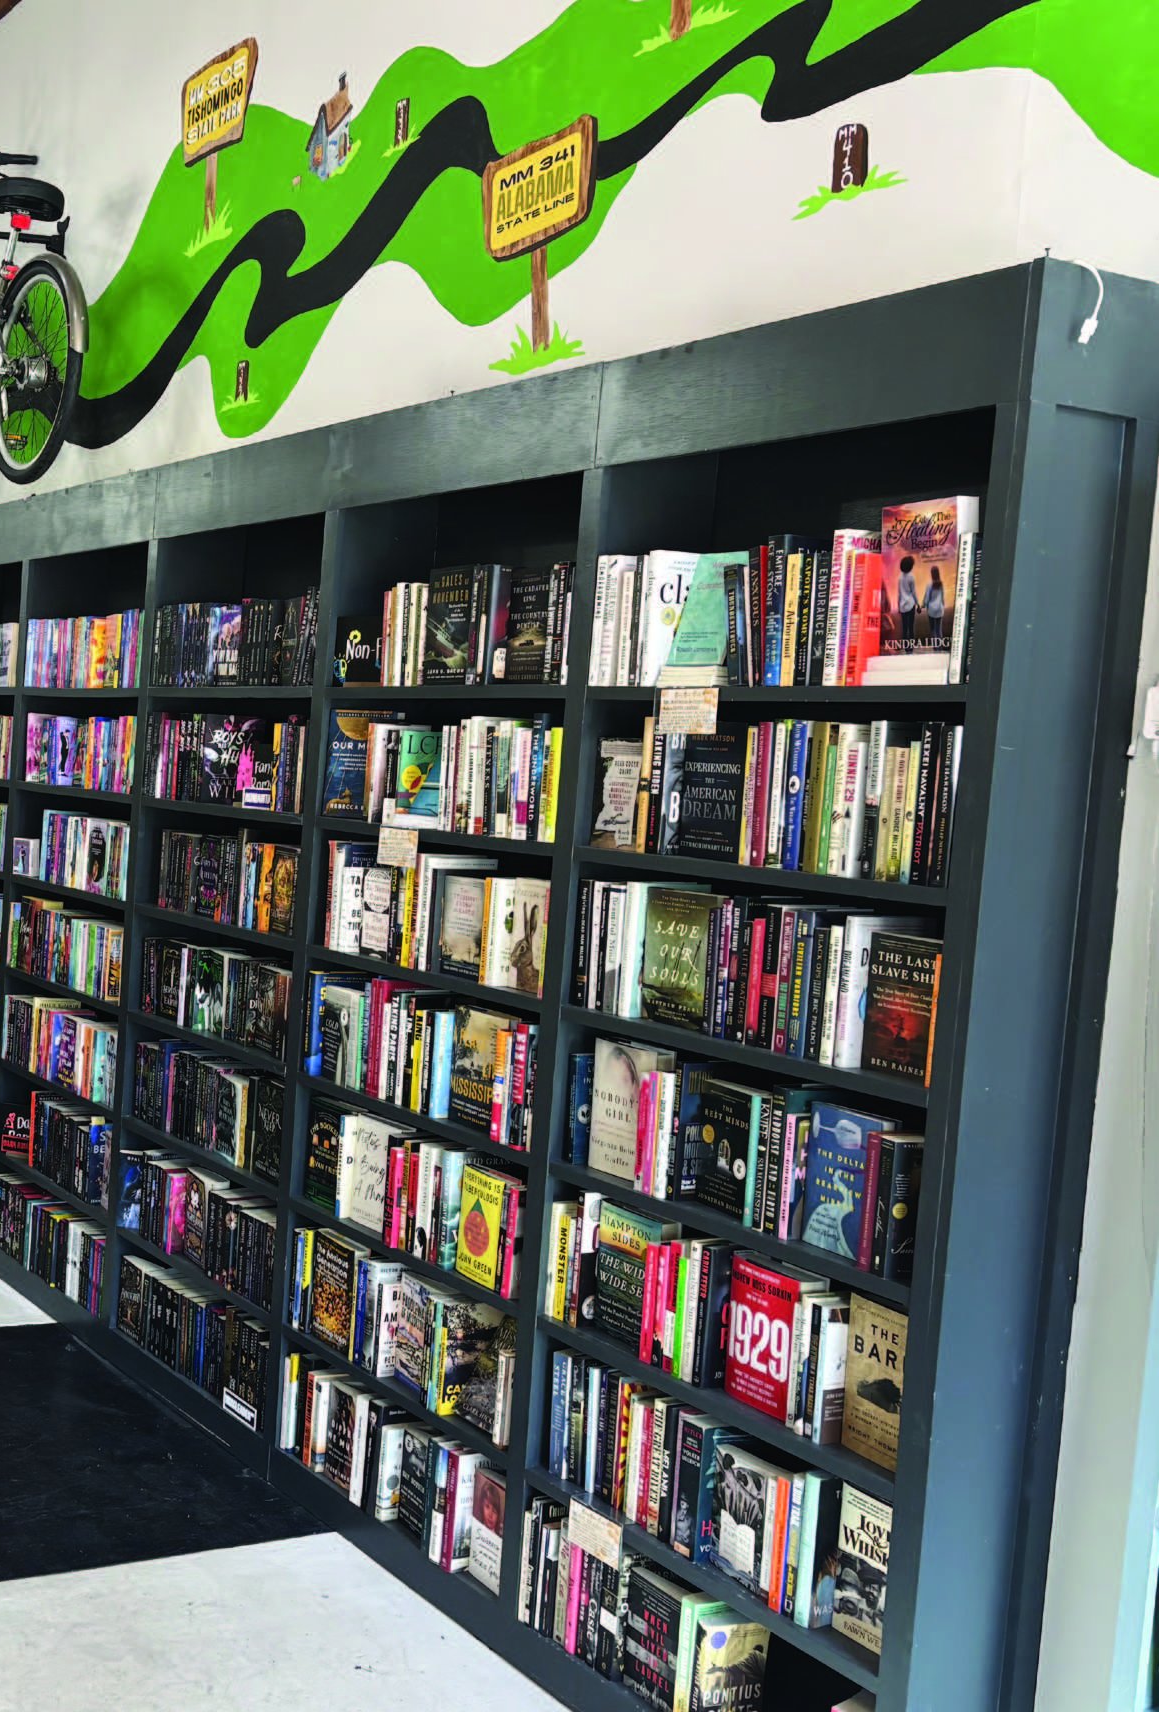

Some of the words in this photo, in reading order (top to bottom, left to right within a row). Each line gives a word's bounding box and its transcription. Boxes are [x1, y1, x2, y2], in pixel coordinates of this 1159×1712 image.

[187, 78, 244, 128] TISHOMINGO
[499, 164, 533, 191] MM
[538, 144, 576, 173] 341
[495, 160, 575, 223] ALABAMA
[495, 206, 541, 235] STATE
[543, 192, 576, 216] LINE
[911, 538, 938, 552] Begin
[774, 549, 784, 587] EMPIRE
[803, 557, 813, 605] CAPOTE'S
[829, 534, 844, 601] MONEYBALL
[751, 569, 760, 627] ANXIOUS
[766, 571, 774, 606] STONE
[814, 568, 828, 636] ENDURANCE
[800, 607, 810, 643] WOMEN
[826, 605, 839, 643] MICHAEL
[824, 643, 836, 669] LEWIS
[884, 639, 922, 650] KINDRA
[332, 741, 356, 751] OUR
[484, 732, 492, 789] WITNESS
[922, 730, 932, 767] ALEXEI
[944, 731, 954, 766] GEORGE
[684, 761, 741, 776] EXPERIENCING
[846, 748, 859, 786] TUNNEL
[528, 755, 538, 821] UNDERWORLD
[651, 770, 660, 795] BIDEN
[683, 784, 737, 801] AMERICAN
[844, 788, 855, 803] 29
[917, 769, 928, 817] NAVALNY
[941, 767, 950, 814] HARRISON
[682, 800, 737, 822] DREAM
[913, 821, 924, 865] PATRIOT
[653, 920, 700, 939] SAVE
[782, 925, 790, 951] WILLIAM
[658, 943, 698, 972] OUR
[795, 942, 804, 976] CIVILIAN
[816, 934, 824, 960] BLACK
[877, 950, 903, 965] THE
[906, 955, 938, 970] LAST
[649, 965, 700, 987] SOULS
[840, 949, 852, 993] DREAMLAND
[871, 964, 909, 981] SLAVE
[912, 971, 935, 985] SHI
[738, 981, 746, 1025] MATCHES
[792, 979, 801, 1017] WARRIORS
[390, 996, 399, 1032] TAKING
[415, 1015, 423, 1041] KING
[810, 1015, 818, 1045] PRADO
[388, 1033, 398, 1062] PARIS
[871, 1057, 888, 1068] BEN
[891, 1061, 925, 1077] RAINES
[604, 1106, 632, 1125] GIRL
[704, 1108, 724, 1120] BEST
[725, 1113, 750, 1130] MINDS
[760, 1103, 770, 1140] KNIFE
[771, 1109, 782, 1155] MADHOUSE
[768, 1164, 778, 1182] END
[817, 1148, 833, 1160] THE
[837, 1154, 865, 1170] DELTA
[824, 1165, 834, 1175] IN
[839, 1169, 855, 1182] THE
[493, 1183, 502, 1194] IS
[384, 1196, 394, 1229] FEAR
[766, 1190, 776, 1218] EARTH
[602, 1212, 653, 1243] HAMPTON
[611, 1229, 642, 1252] SIDES
[472, 1257, 492, 1277] GREEN
[556, 1226, 568, 1284] MONSTER
[599, 1251, 623, 1272] THE
[622, 1258, 646, 1281] WID
[702, 1250, 710, 1274] CABIN
[598, 1270, 627, 1291] WIDE
[699, 1275, 708, 1299] FEVER
[752, 1278, 766, 1294] ROSS
[767, 1281, 792, 1302] SORKIN
[728, 1300, 790, 1384] 1929
[870, 1323, 900, 1346] THE
[854, 1333, 898, 1371] BAR
[607, 1407, 616, 1449] RESTLESS
[655, 1408, 663, 1430] THE
[651, 1432, 662, 1465] GREAT
[649, 1466, 659, 1504] RIVER
[660, 1449, 670, 1498] MELANIA
[587, 1599, 598, 1641] Caste
[643, 1608, 668, 1635] WHEN
[843, 1621, 866, 1641] FAWN
[635, 1659, 670, 1694] LAUREL
[702, 1683, 762, 1708] PONTIUS
